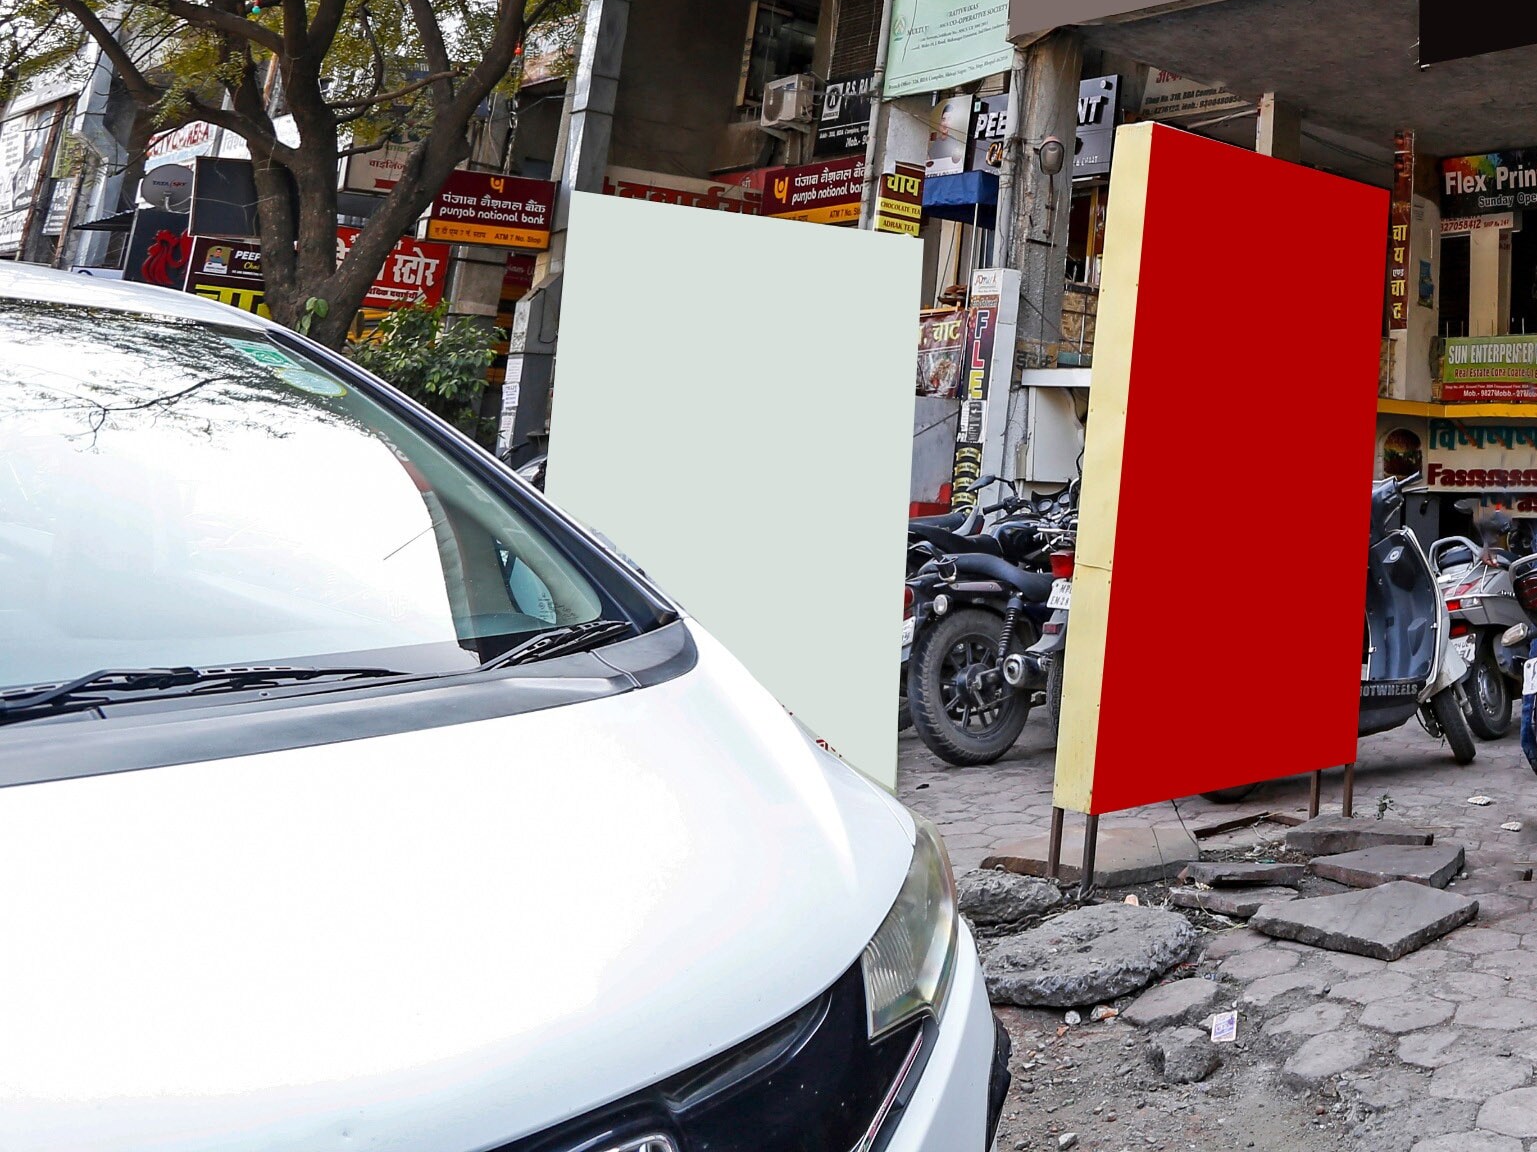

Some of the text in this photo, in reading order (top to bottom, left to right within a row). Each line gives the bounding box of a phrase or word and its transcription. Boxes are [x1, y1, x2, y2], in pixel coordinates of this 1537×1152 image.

[1445, 171, 1487, 195] Flex
[792, 180, 867, 206] punjab national ban
[525, 199, 546, 213] बैंक
[1478, 194, 1514, 208] Sunday
[440, 206, 545, 225] punjab national bank
[829, 209, 840, 220] ATM
[880, 201, 921, 217] CHOCOLATE TEA
[882, 220, 915, 233] ADRAK TEA
[494, 233, 508, 241] ATM
[515, 235, 525, 243] No.
[527, 236, 541, 245] Stop
[1448, 345, 1468, 364] SUN
[1361, 683, 1418, 697] OTWHEELS
